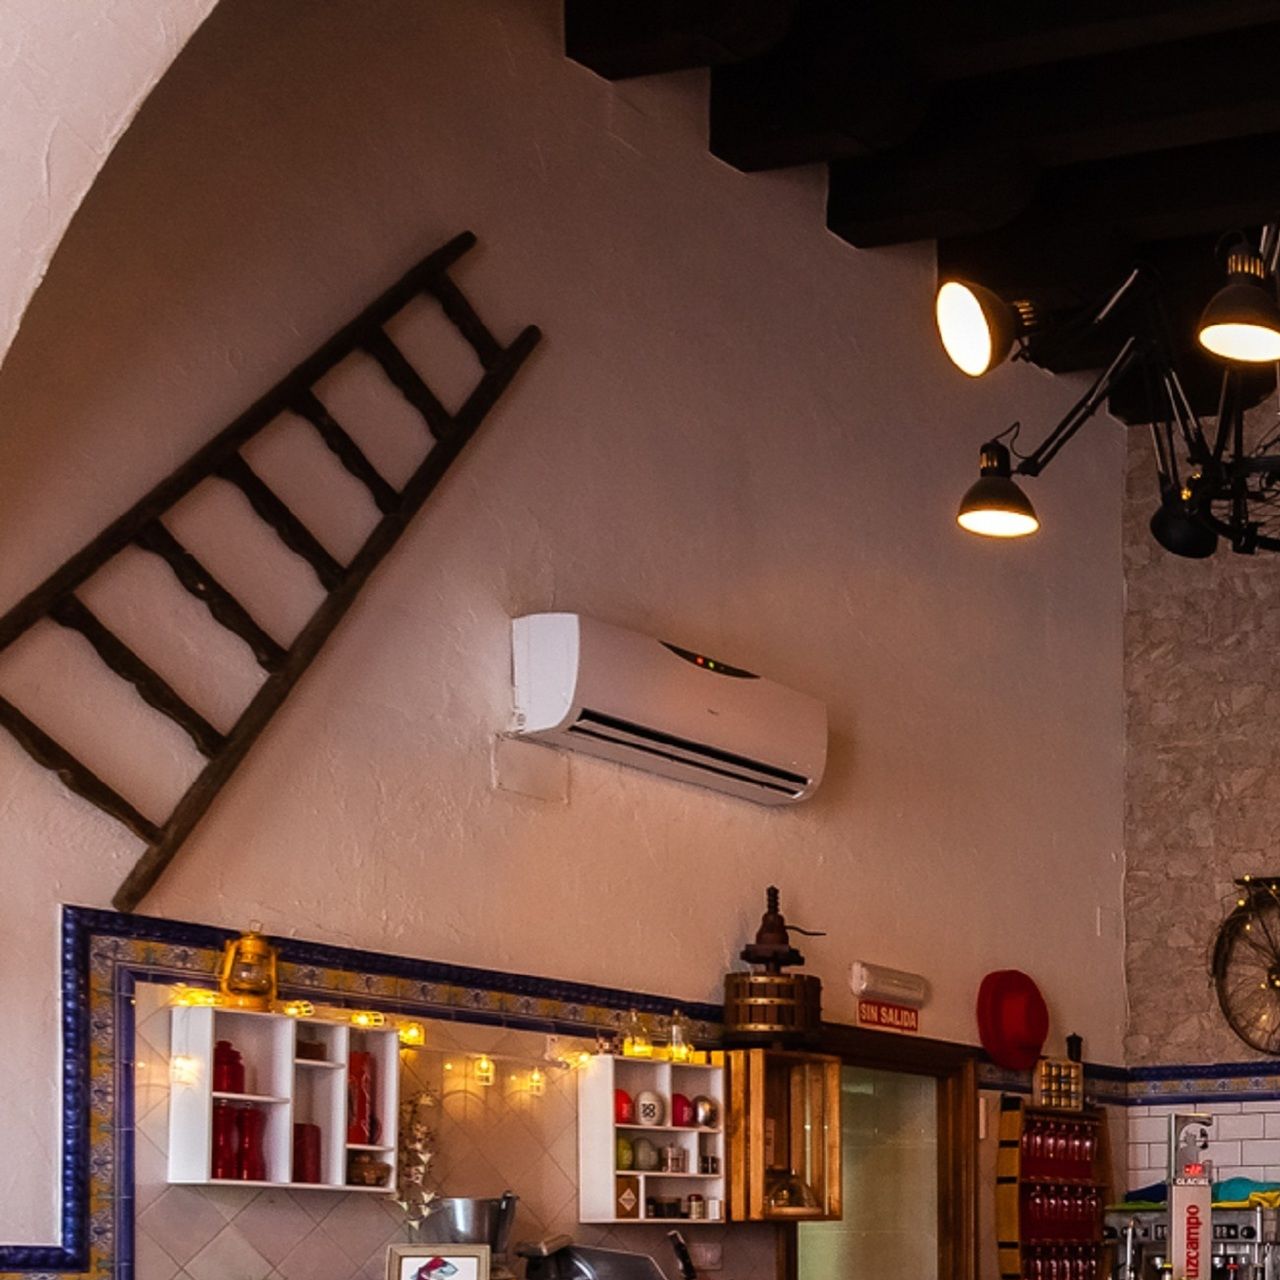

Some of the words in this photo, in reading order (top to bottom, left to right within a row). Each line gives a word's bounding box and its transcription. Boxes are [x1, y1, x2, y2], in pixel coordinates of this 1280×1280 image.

[860, 1003, 878, 1021] SIN
[880, 1006, 917, 1028] SALIDA
[1186, 1204, 1203, 1279] uzcampo
